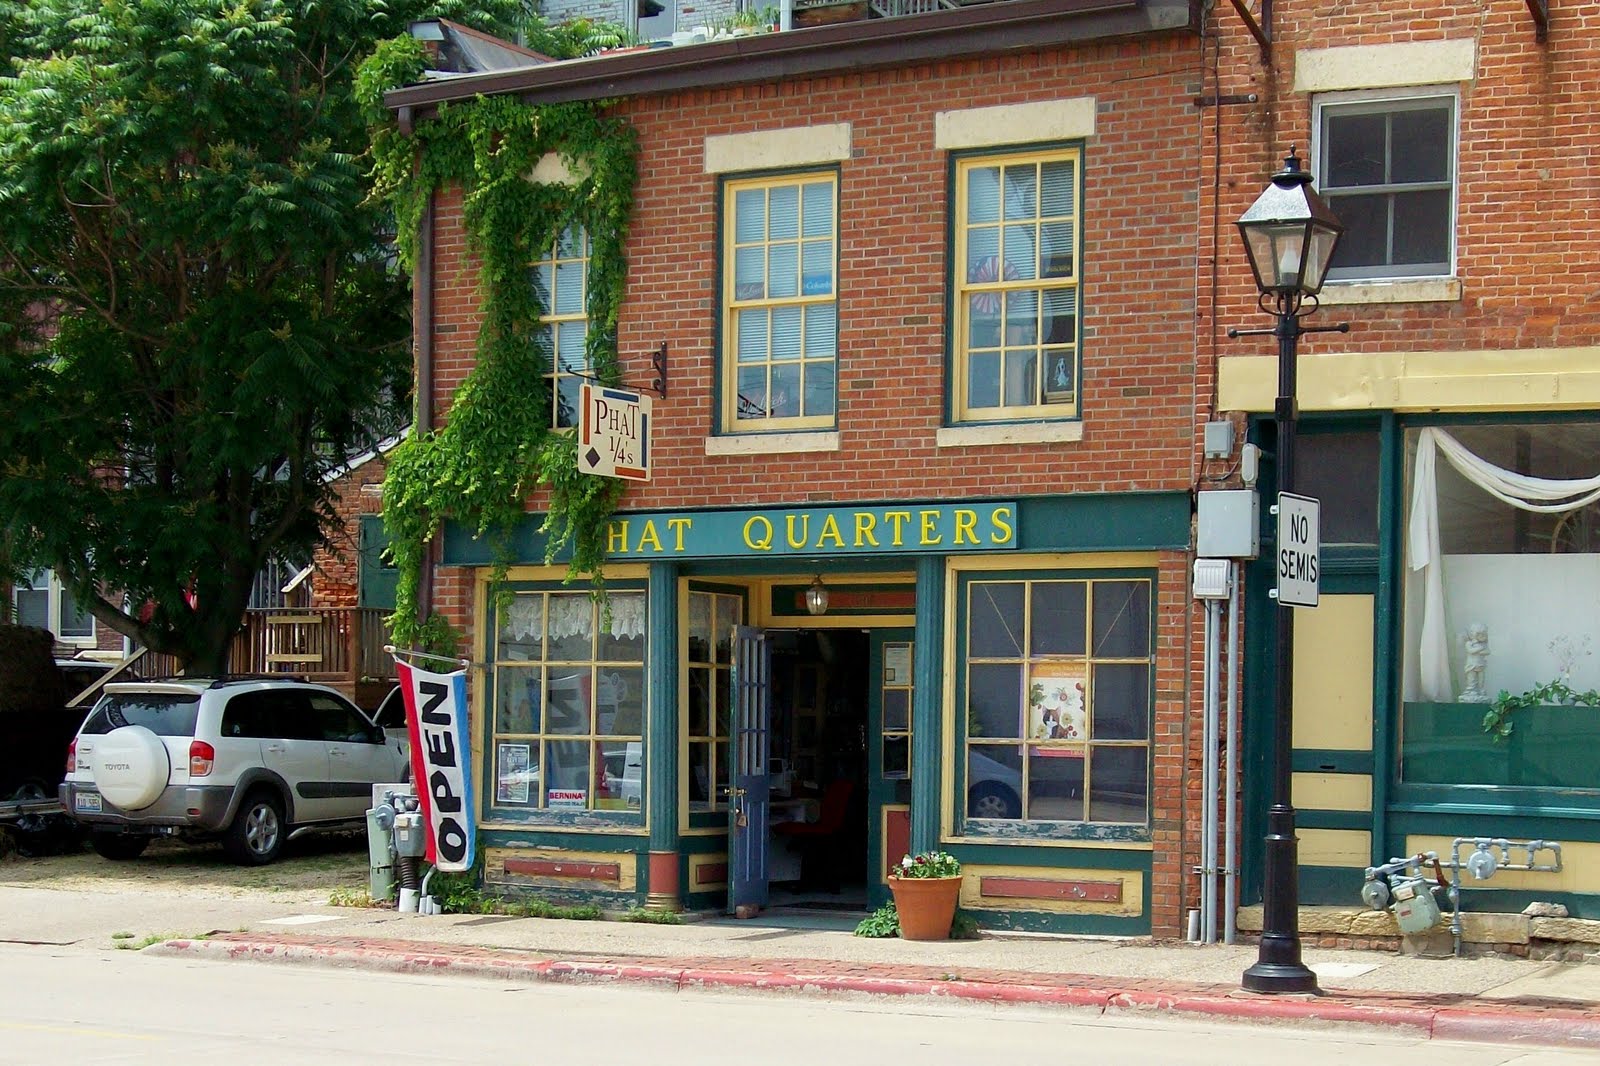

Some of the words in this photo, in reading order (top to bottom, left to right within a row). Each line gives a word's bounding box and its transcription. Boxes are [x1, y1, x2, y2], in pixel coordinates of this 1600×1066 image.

[594, 399, 640, 440] PHAT
[605, 517, 692, 553] HAT
[743, 507, 1013, 552] QUARTERS
[1290, 513, 1308, 544] NO
[1280, 548, 1317, 583] SEMIS
[104, 763, 130, 771] TOYOTA
[419, 680, 467, 863] OPEN
